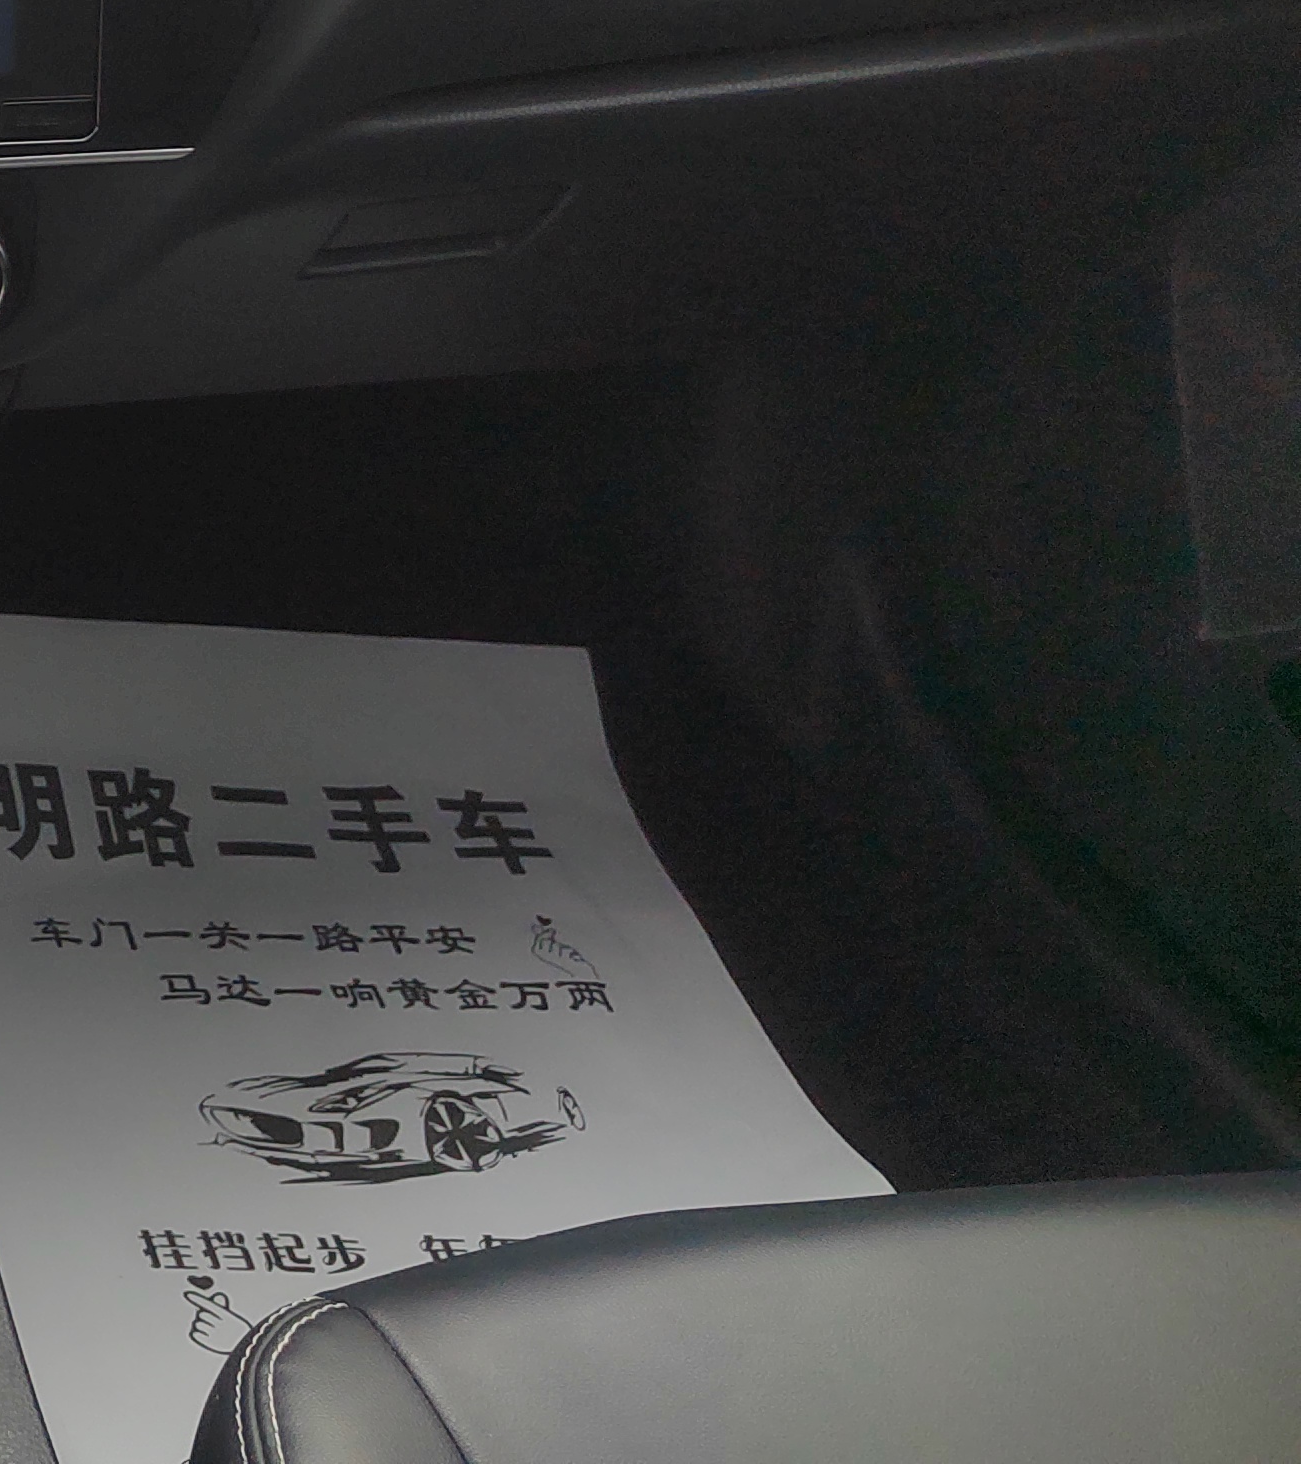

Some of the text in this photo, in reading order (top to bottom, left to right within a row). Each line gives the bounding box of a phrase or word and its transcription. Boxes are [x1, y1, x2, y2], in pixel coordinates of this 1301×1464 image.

[30, 916, 477, 955] 车门一关一路平安
[159, 973, 614, 1013] 马达一响黄金万两
[138, 1227, 367, 1275] 挂挡起步
